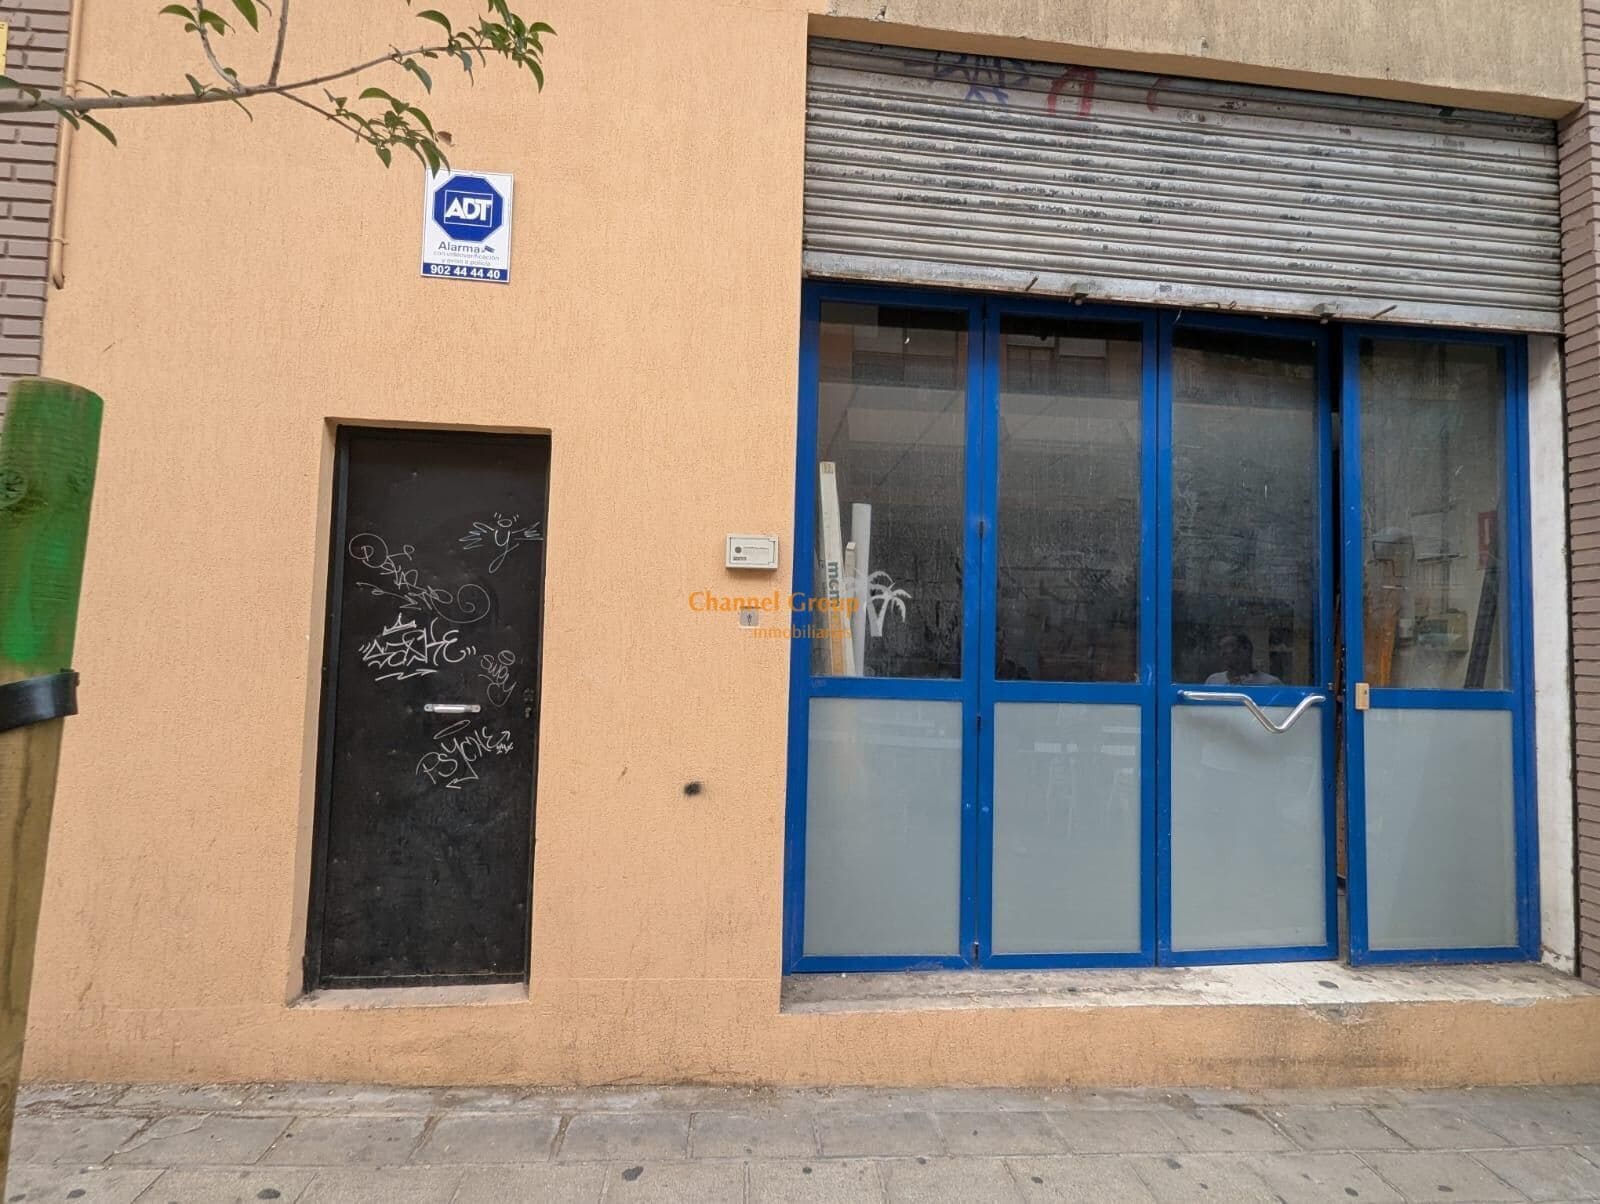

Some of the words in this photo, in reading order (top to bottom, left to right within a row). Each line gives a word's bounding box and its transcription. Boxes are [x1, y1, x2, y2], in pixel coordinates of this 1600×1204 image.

[445, 197, 492, 221] ADT
[438, 241, 480, 253] Alarma
[430, 264, 451, 275] 902
[453, 266, 467, 276] 44
[470, 268, 484, 278] 44
[487, 269, 501, 279] 40
